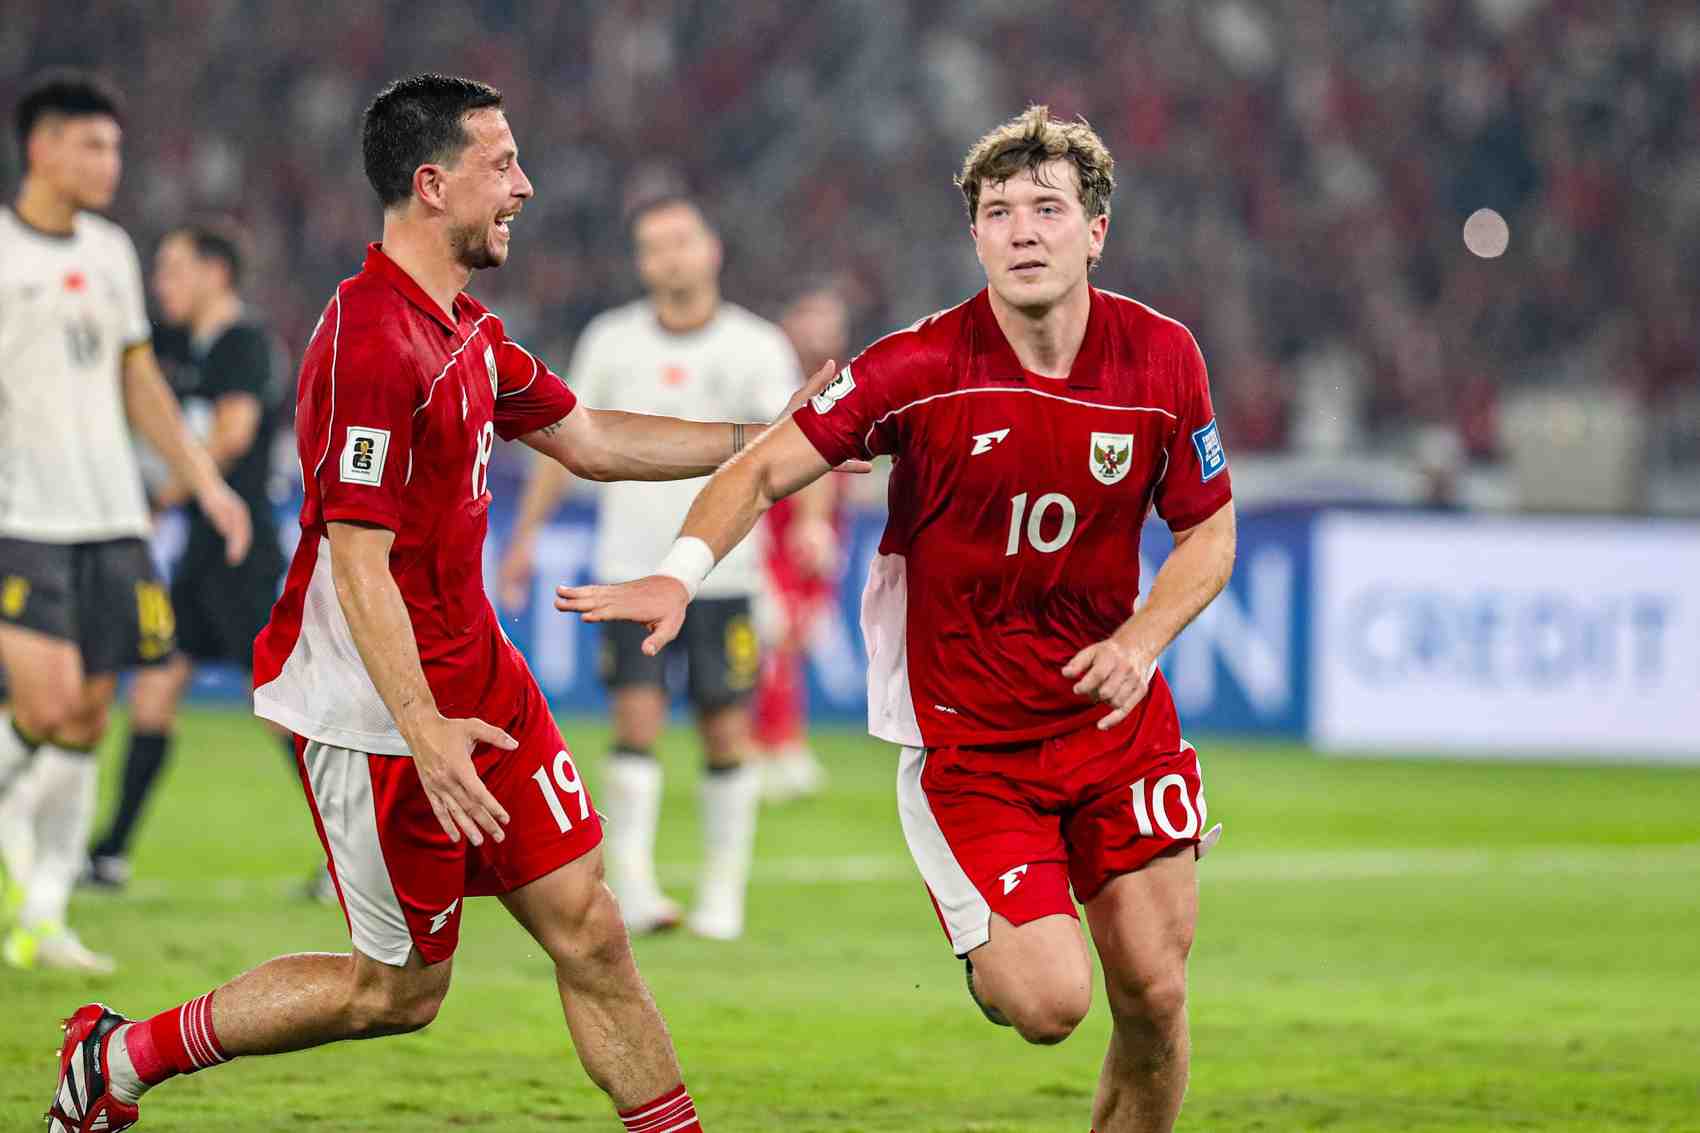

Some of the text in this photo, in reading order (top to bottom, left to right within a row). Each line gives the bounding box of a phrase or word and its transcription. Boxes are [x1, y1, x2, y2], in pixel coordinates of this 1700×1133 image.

[472, 420, 494, 500] 19
[1005, 491, 1077, 557] 10
[532, 750, 590, 834] 19
[1130, 774, 1198, 839] 10
